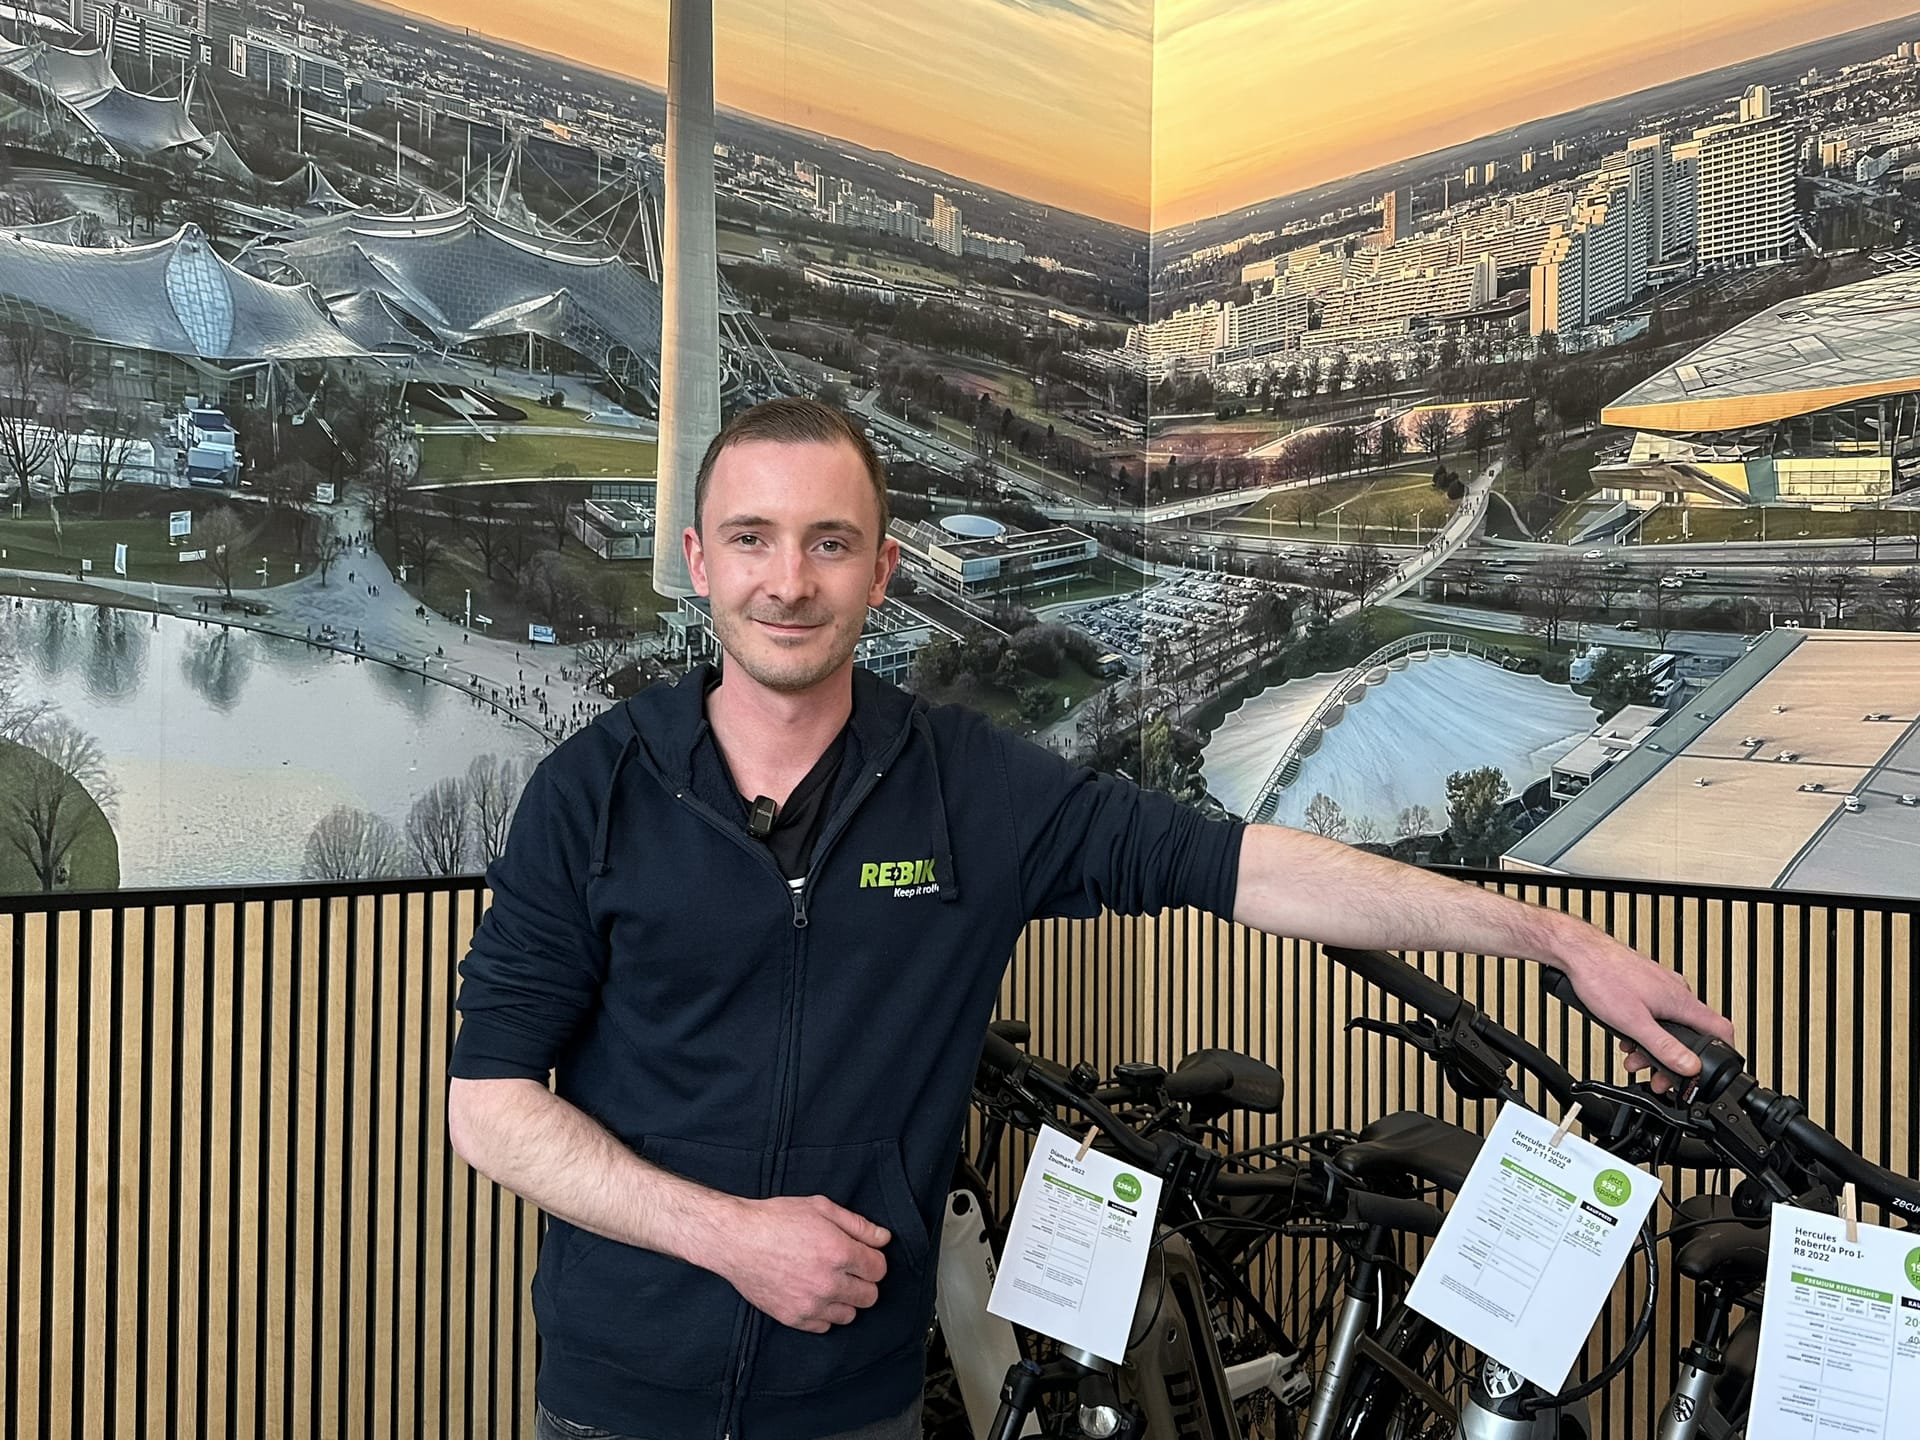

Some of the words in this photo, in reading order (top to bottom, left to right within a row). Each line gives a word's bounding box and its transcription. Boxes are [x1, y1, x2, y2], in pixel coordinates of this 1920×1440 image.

[859, 858, 936, 888] REBIK
[893, 887, 915, 899] Keep
[915, 886, 922, 895] it
[1511, 1137, 1533, 1153] Comp
[1548, 1156, 1567, 1170] 2022
[1515, 1130, 1546, 1150] Hercules
[1547, 1147, 1572, 1164] Futura
[1050, 1148, 1074, 1165] Diamant
[1601, 1180, 1617, 1192] 930
[1576, 1215, 1601, 1233] 3.269
[1795, 1226, 1837, 1243] Hercules
[1793, 1247, 1806, 1257] R8
[1807, 1250, 1831, 1262] 2022
[1794, 1237, 1837, 1253] Robert/a
[1838, 1246, 1855, 1257] Pro
[1804, 1277, 1835, 1290] PREMIUM
[1904, 1316, 1920, 1328] 20
